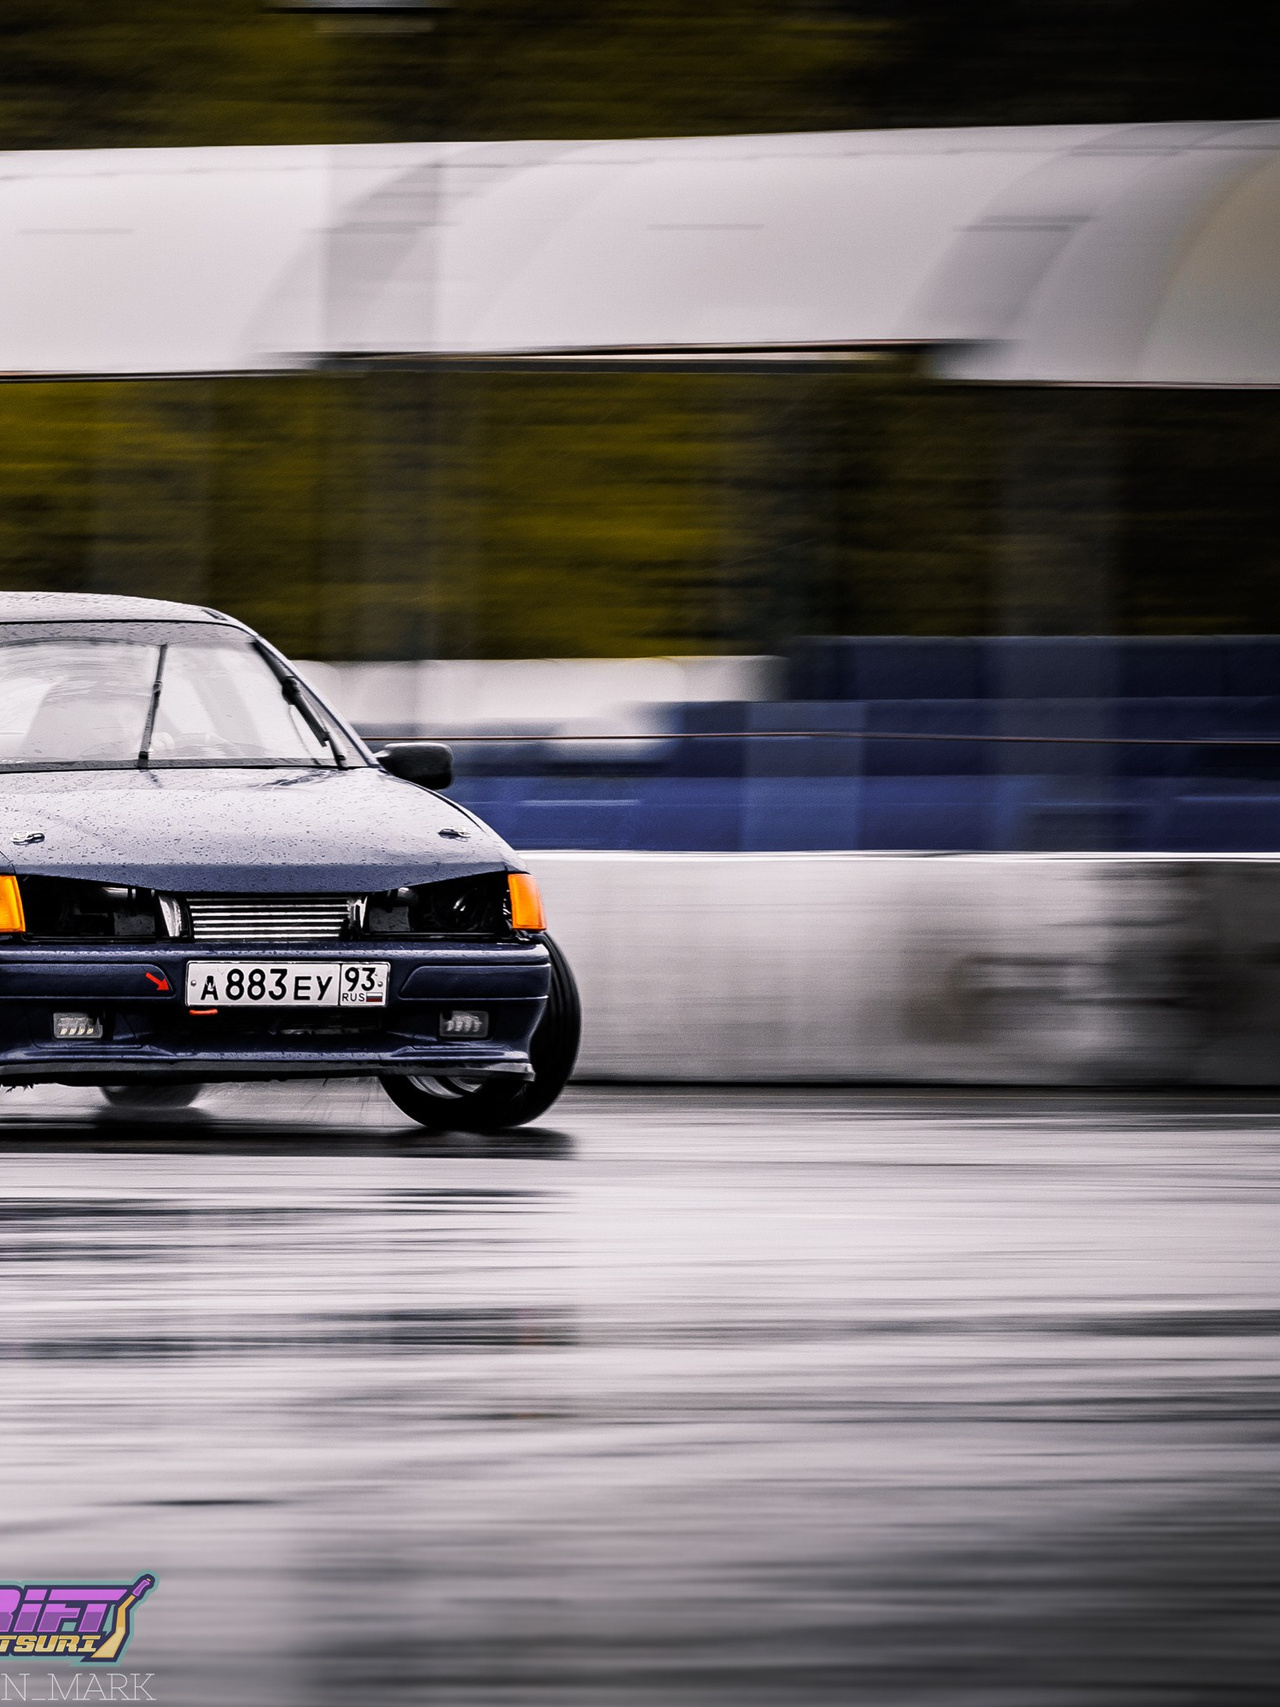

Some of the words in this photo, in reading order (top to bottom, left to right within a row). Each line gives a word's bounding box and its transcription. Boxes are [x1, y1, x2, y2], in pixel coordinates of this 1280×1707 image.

[200, 967, 333, 1001] А883ЕУ
[344, 966, 376, 992] 93
[341, 992, 365, 1002] RUS
